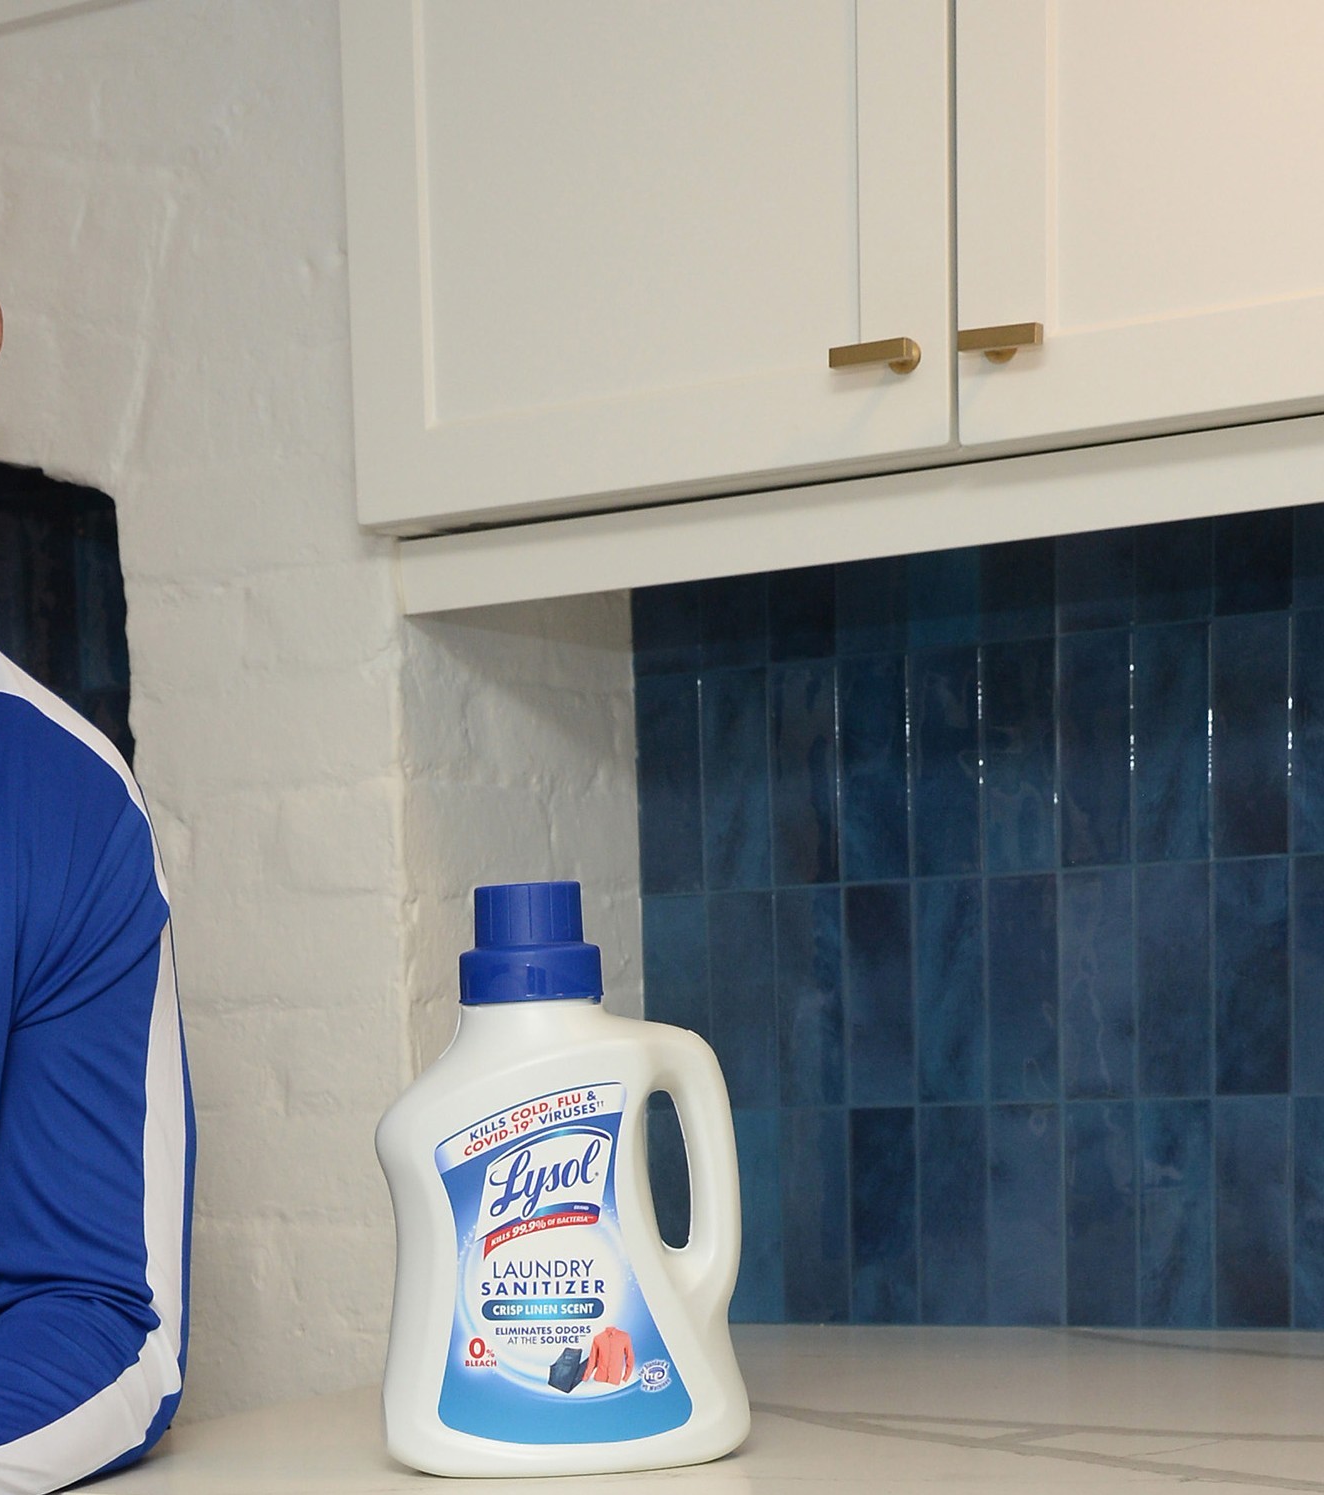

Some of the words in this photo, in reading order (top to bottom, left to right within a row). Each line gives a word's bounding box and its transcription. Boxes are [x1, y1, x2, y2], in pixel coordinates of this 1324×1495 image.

[469, 1117, 506, 1142] KILLS
[510, 1102, 552, 1123] COLD,
[557, 1093, 581, 1108] FLU
[586, 1090, 596, 1101] &
[489, 1139, 601, 1218] Lysol
[491, 1231, 510, 1246] KILLS
[512, 1220, 546, 1237] 99.9%
[547, 1218, 556, 1226] OF
[493, 1259, 594, 1279] LAUNDRY
[481, 1280, 605, 1296] SANITIZER
[492, 1304, 523, 1316] CRISP
[525, 1304, 557, 1315] LINEN
[560, 1303, 594, 1315] SCENT
[495, 1326, 552, 1336] ELIMINATES
[555, 1325, 591, 1334] ODORS
[468, 1337, 495, 1359] 0%
[525, 1336, 537, 1344] THE
[464, 1359, 497, 1367] BLEACH
